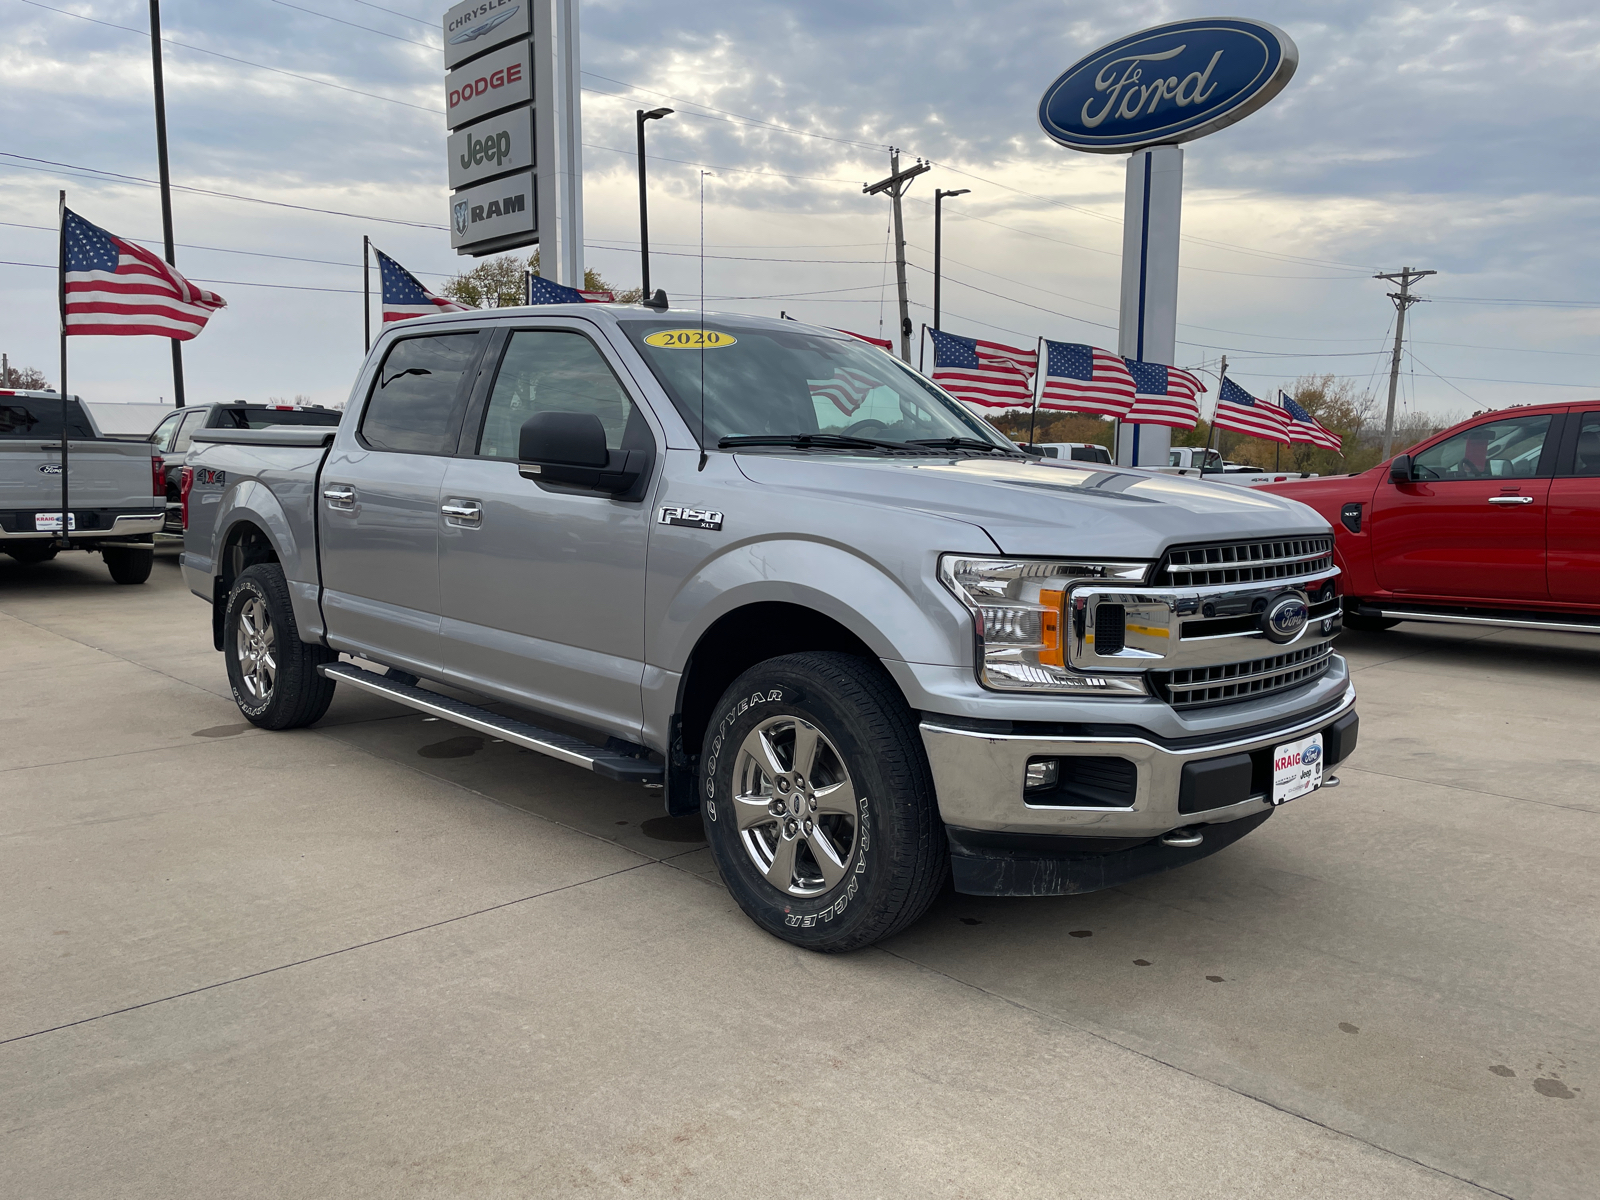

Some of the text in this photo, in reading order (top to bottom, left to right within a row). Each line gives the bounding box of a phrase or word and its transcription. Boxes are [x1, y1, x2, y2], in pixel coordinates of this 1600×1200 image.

[448, 0, 511, 32] CHRYSLE
[449, 63, 522, 109] DODGE
[1080, 44, 1224, 129] Ford
[460, 130, 511, 170] Jeep
[471, 194, 525, 224] RAM
[662, 331, 720, 346] 2020
[1281, 607, 1303, 628] Ford
[706, 689, 783, 822] GOODYEAR
[1275, 747, 1319, 772] KRAIG Ford
[1300, 769, 1312, 780] Jeep
[784, 797, 871, 928] WRANGLER
